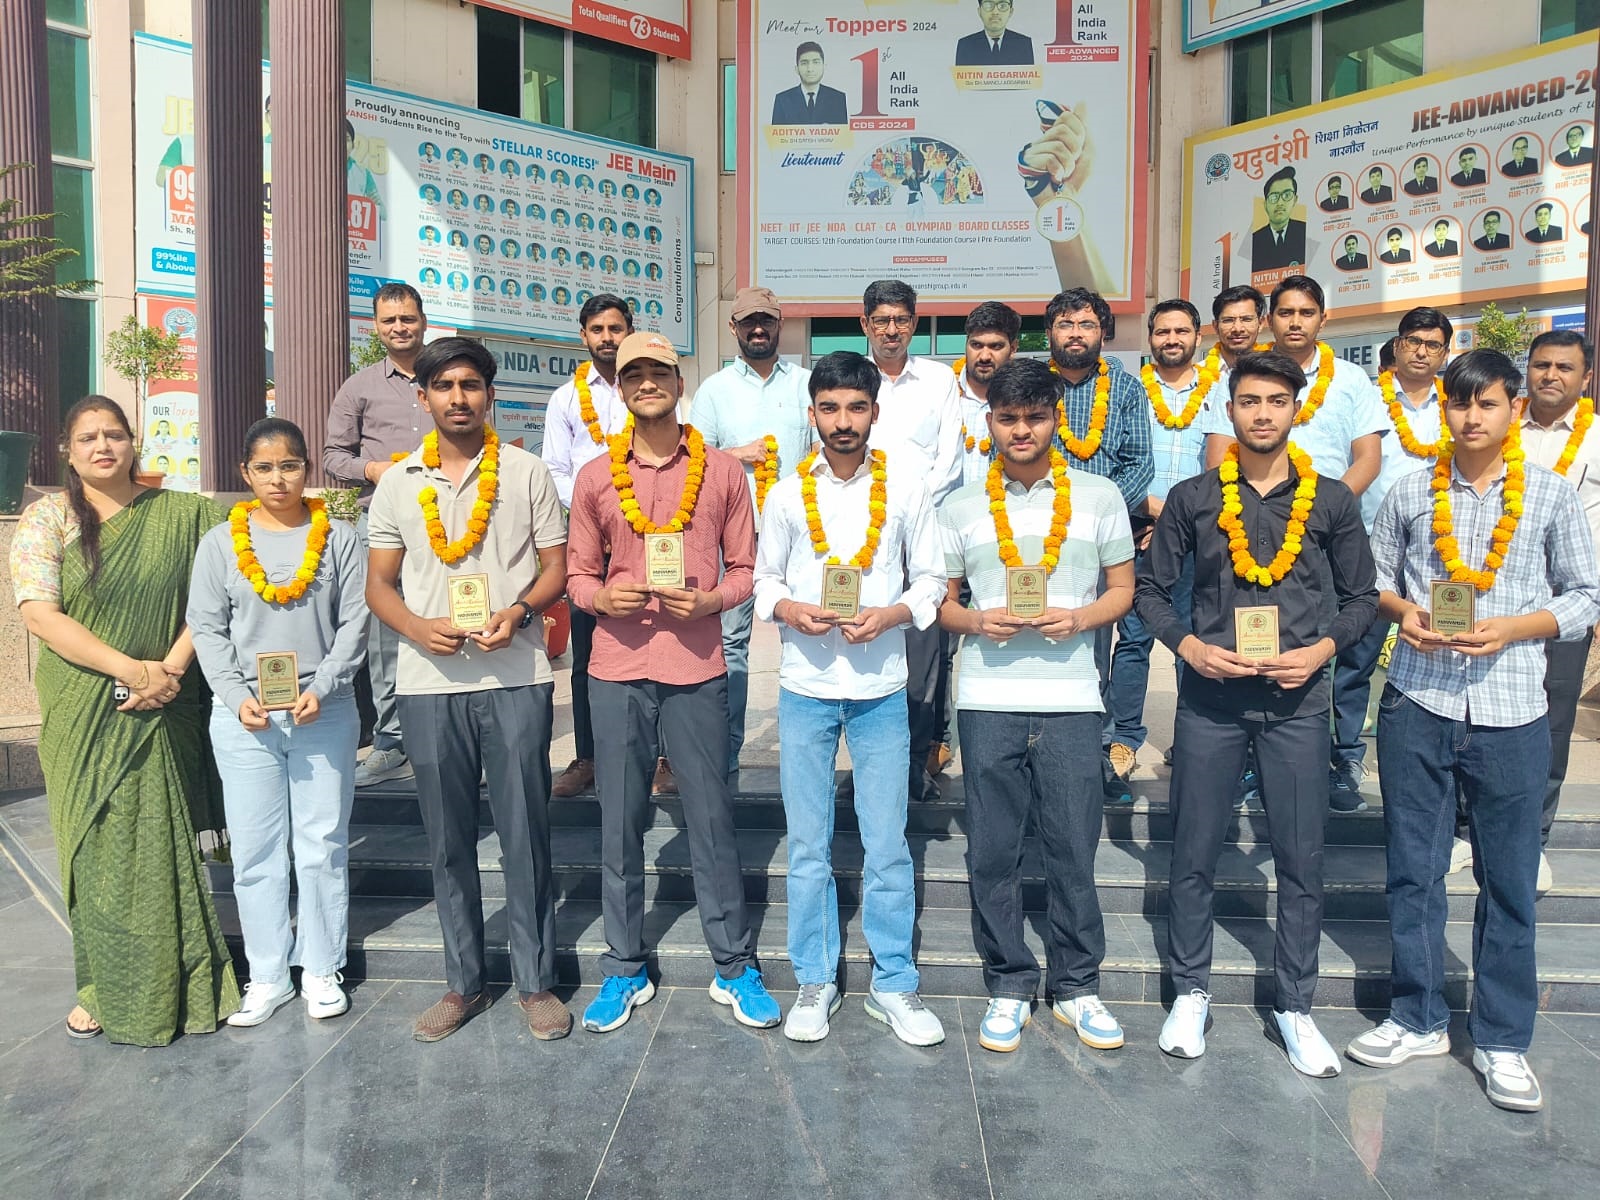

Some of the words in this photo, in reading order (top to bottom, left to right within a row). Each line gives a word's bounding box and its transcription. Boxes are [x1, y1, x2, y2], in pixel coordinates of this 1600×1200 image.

[1077, 4, 1093, 14] All
[579, 5, 595, 18] Total
[596, 10, 628, 27] Qualifiers
[633, 18, 648, 36] 73
[652, 27, 680, 43] Students
[766, 19, 804, 35] Meet
[825, 17, 907, 36] Toppers
[912, 22, 937, 31] 2024
[1077, 17, 1106, 28] India
[1077, 31, 1107, 41] Rank
[890, 71, 906, 81] All
[956, 71, 983, 79] NITIN
[986, 71, 1040, 79] AGGARWAL
[850, 47, 889, 116] 1
[890, 84, 918, 94] India
[890, 98, 920, 108] Rank
[354, 98, 397, 117] Proudly
[399, 109, 461, 130] announcing
[878, 121, 908, 129] 2024
[1372, 143, 1405, 157] Unique
[1405, 131, 1465, 151] Performance
[1466, 127, 1479, 138] by
[1480, 120, 1515, 135] unique
[1517, 108, 1564, 127] Students
[1569, 101, 1583, 114] of
[772, 128, 806, 136] ADITYA
[810, 128, 841, 136] YADAV
[1315, 130, 1339, 145] शिक्षा
[1342, 120, 1379, 140] निकेतन
[380, 116, 415, 130] Students
[417, 123, 433, 134] Rise
[435, 128, 443, 136] to
[445, 130, 458, 138] the
[459, 132, 473, 143] Top
[475, 137, 491, 146] with
[492, 138, 543, 159] STELLAR
[546, 149, 595, 171] SCORES!
[1329, 140, 1365, 159] नारनौल
[781, 151, 845, 168] Lieutenant
[1233, 128, 1310, 180] यदुवंशी
[606, 152, 633, 173] JEE
[638, 158, 676, 182] Main
[169, 225, 183, 234] Sh.
[760, 223, 783, 233] NEET
[789, 222, 801, 232] IIT
[807, 223, 821, 234] JEE
[827, 222, 846, 232] NDA
[855, 222, 877, 232] CLAT
[885, 222, 897, 232] CA
[905, 221, 952, 232] OLYMPIAD
[958, 221, 990, 231] BOARD
[991, 220, 1030, 231] CLASSES
[348, 240, 368, 251] YA
[764, 237, 787, 245] TARGET
[790, 237, 820, 245] COURSES:
[822, 237, 836, 245] 12th
[837, 237, 874, 245] Foundation
[875, 237, 897, 245] Course
[915, 236, 953, 244] Foundation
[954, 236, 977, 244] Course
[994, 235, 1032, 243] Foundation
[156, 252, 188, 263] 99%ile
[1214, 231, 1232, 289] 1
[156, 260, 164, 269] &
[165, 261, 195, 273] Above
[673, 238, 684, 324] Congratulations
[1253, 271, 1279, 283] NITIN
[1212, 278, 1220, 290] All
[349, 286, 371, 295] bove
[504, 351, 540, 374] NDA
[153, 405, 170, 416] OUR
